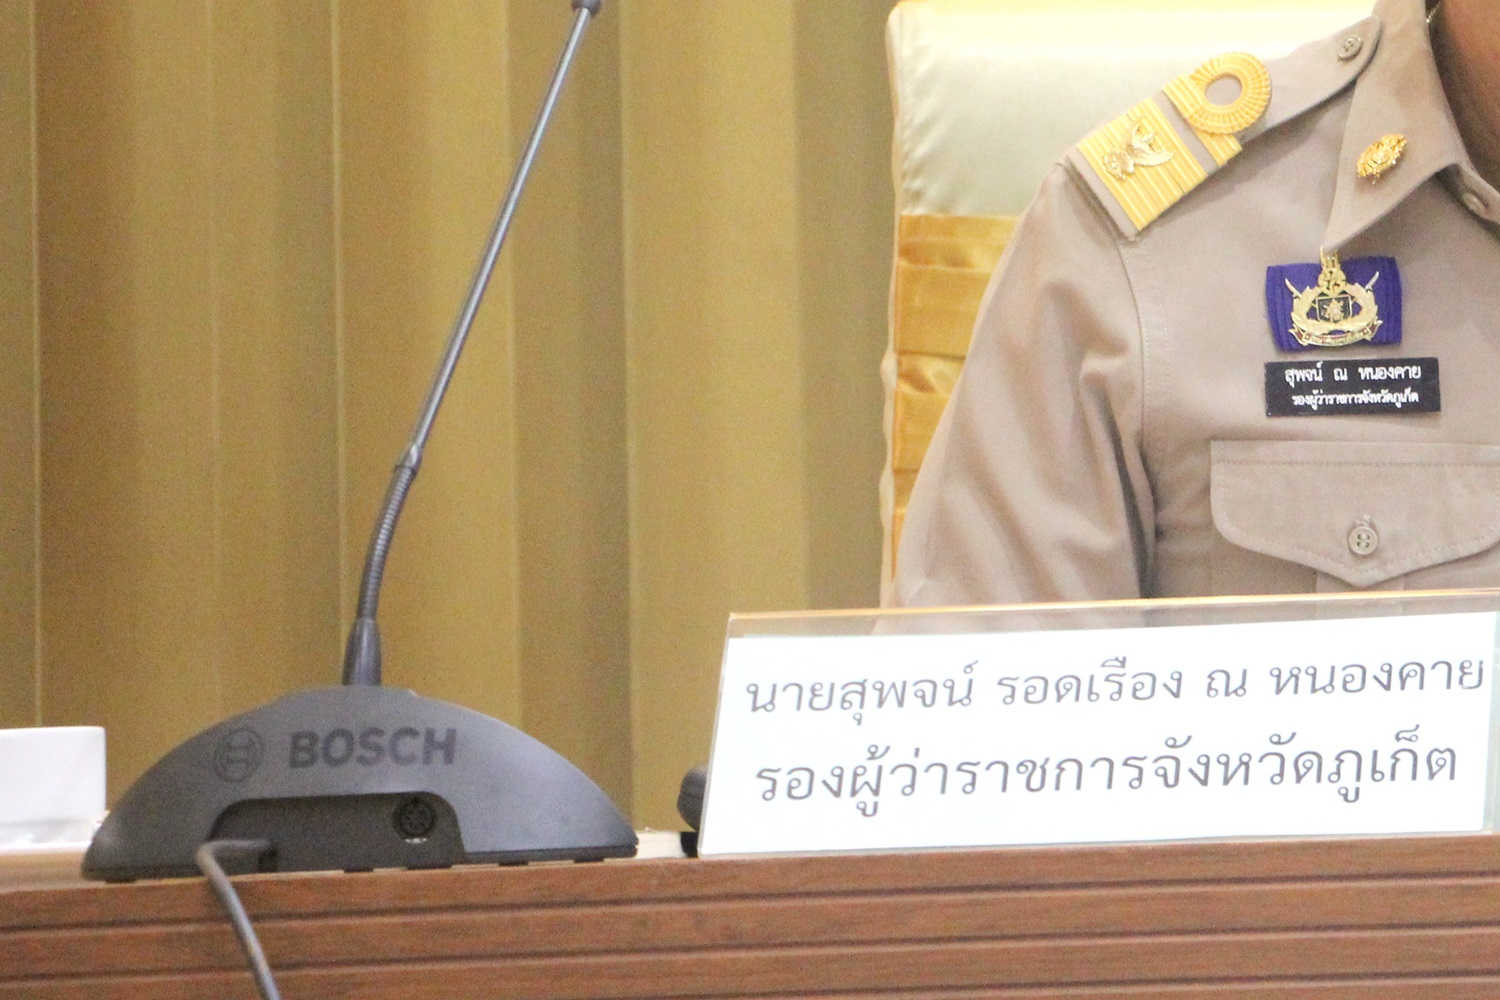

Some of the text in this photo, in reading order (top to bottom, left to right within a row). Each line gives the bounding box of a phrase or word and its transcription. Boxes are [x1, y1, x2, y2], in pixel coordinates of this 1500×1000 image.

[1285, 361, 1421, 388] สุพจน์ ณ หนองคาย
[1292, 387, 1420, 410] รองผู้ว่าราชการจังหวัดภูเก็ต
[746, 655, 1485, 726] นายสุพจน์ รอดเรือง ณ หนองคาย
[289, 726, 457, 769] BOSCH
[755, 723, 1457, 818] รองผู้ว่าราชการจังหวัดภูเก็ต
